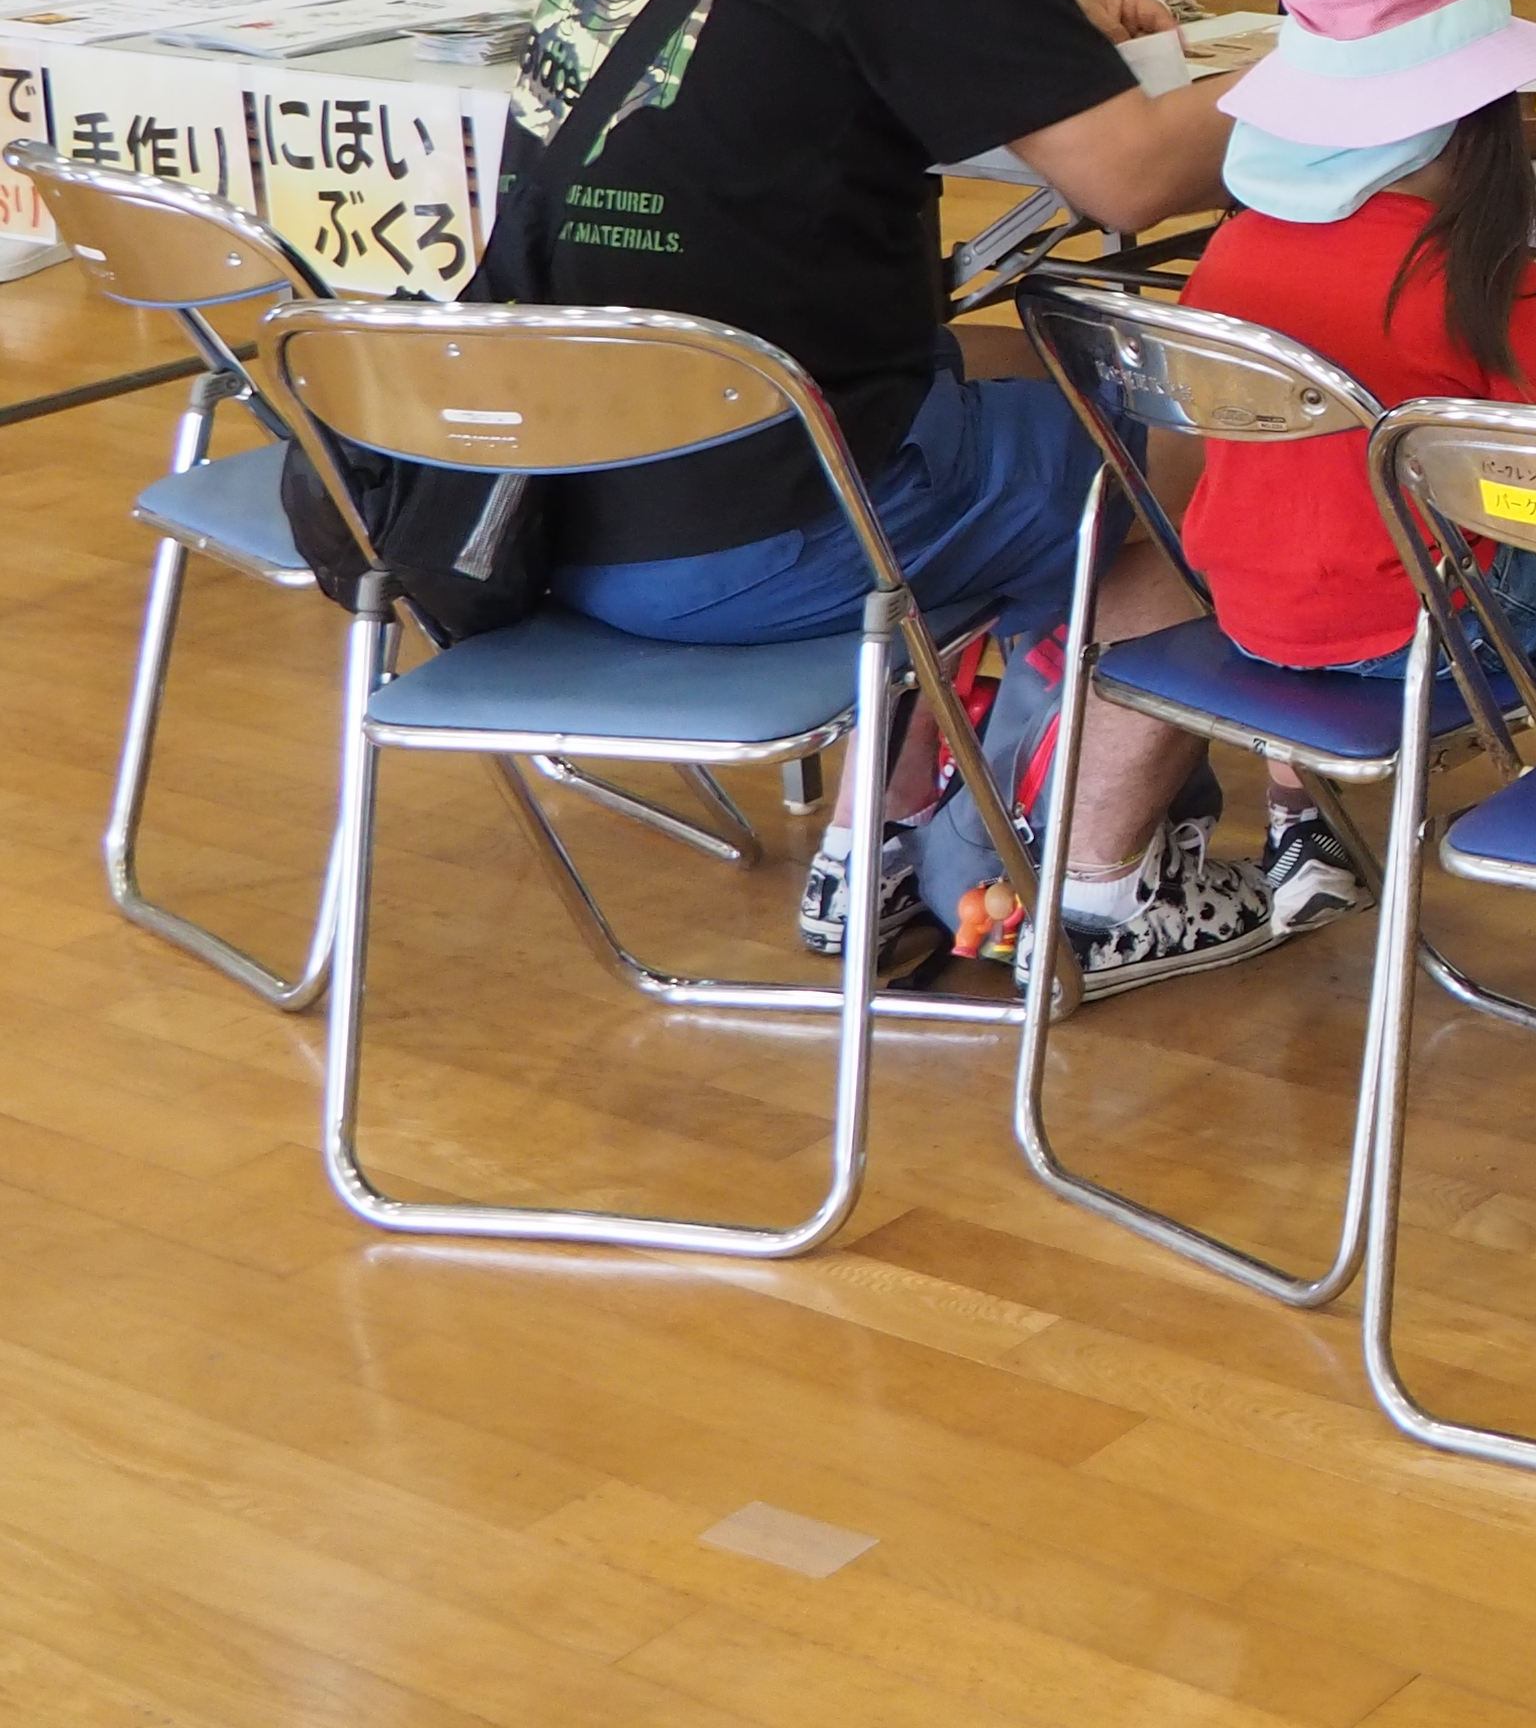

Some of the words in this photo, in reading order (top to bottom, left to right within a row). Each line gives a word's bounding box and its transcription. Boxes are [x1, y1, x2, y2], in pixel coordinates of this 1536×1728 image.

[72, 112, 229, 199] 手作り
[265, 94, 436, 181] にほい
[315, 189, 467, 281] ぶくろ
